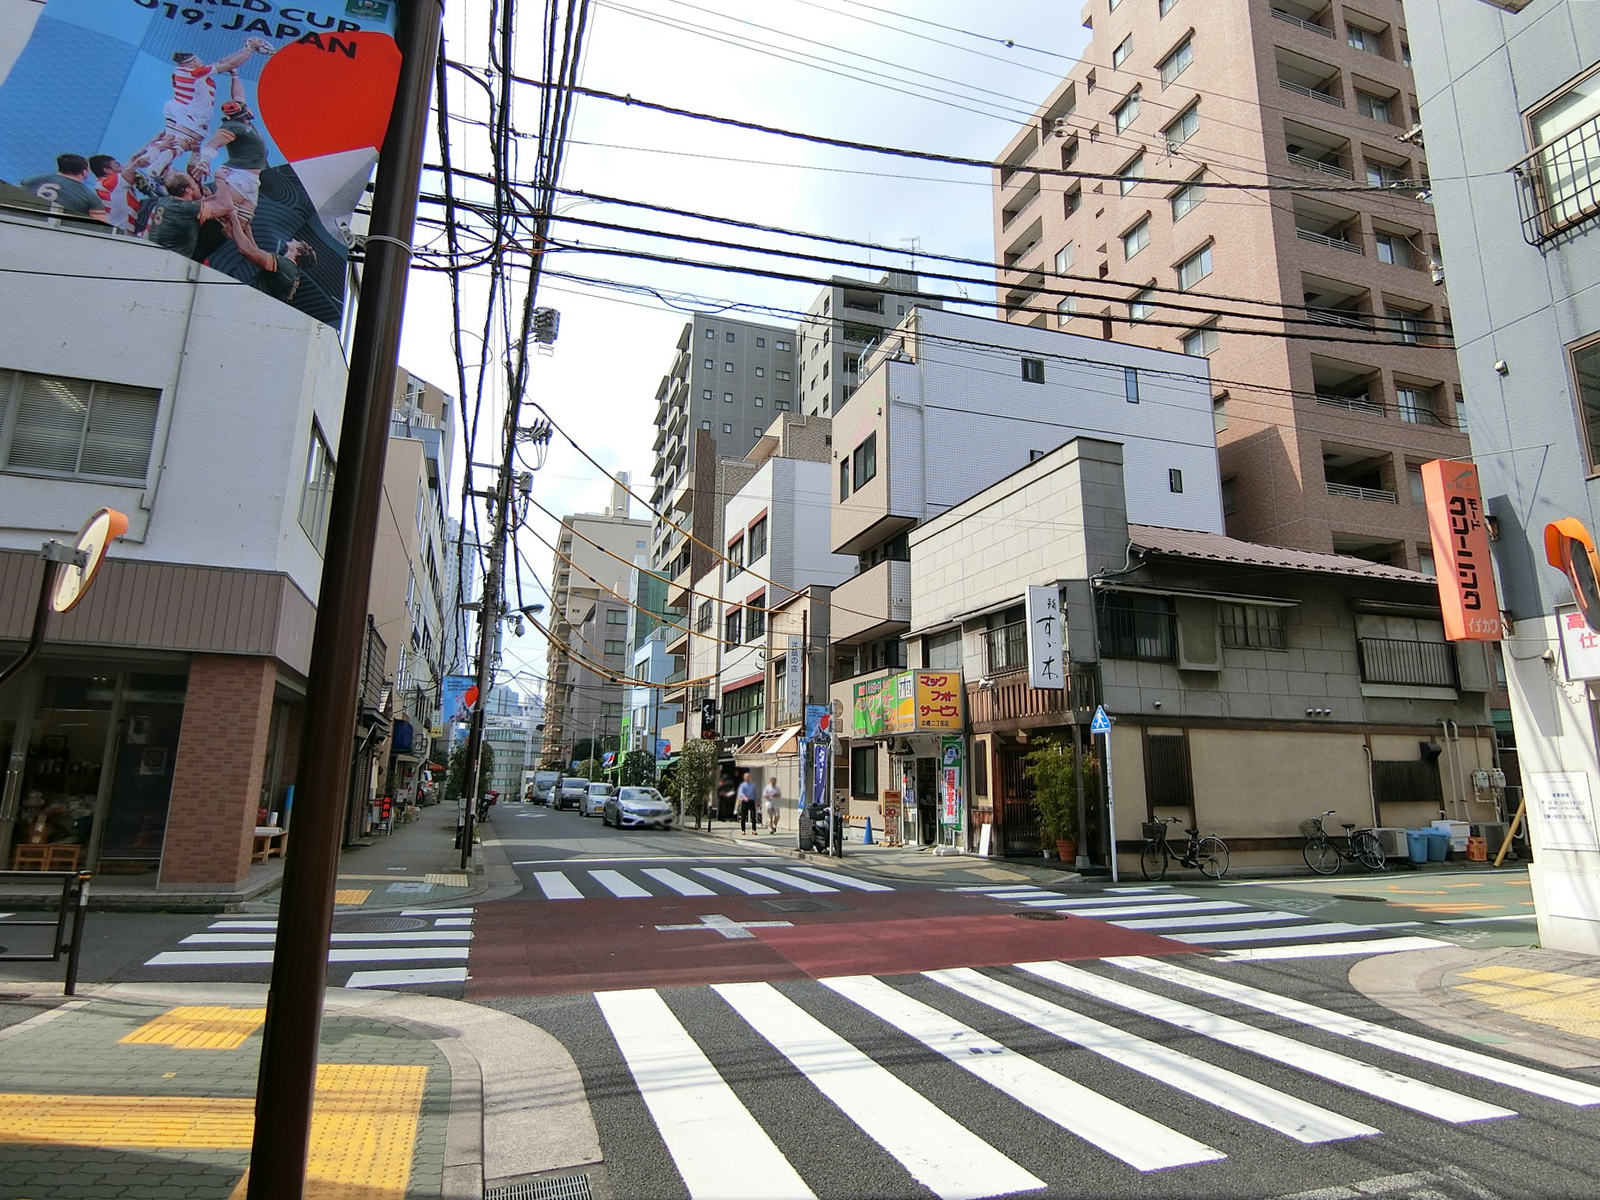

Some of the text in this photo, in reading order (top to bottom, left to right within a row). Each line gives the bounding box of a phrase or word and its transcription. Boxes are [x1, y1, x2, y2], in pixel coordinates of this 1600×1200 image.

[280, 8, 361, 34] CUP
[221, 13, 358, 60] JAPAN
[1467, 498, 1481, 531] モード
[1449, 496, 1481, 610] クリーニング
[789, 679, 799, 708] じゅん
[920, 675, 948, 687] マック
[920, 705, 959, 717] サービス
